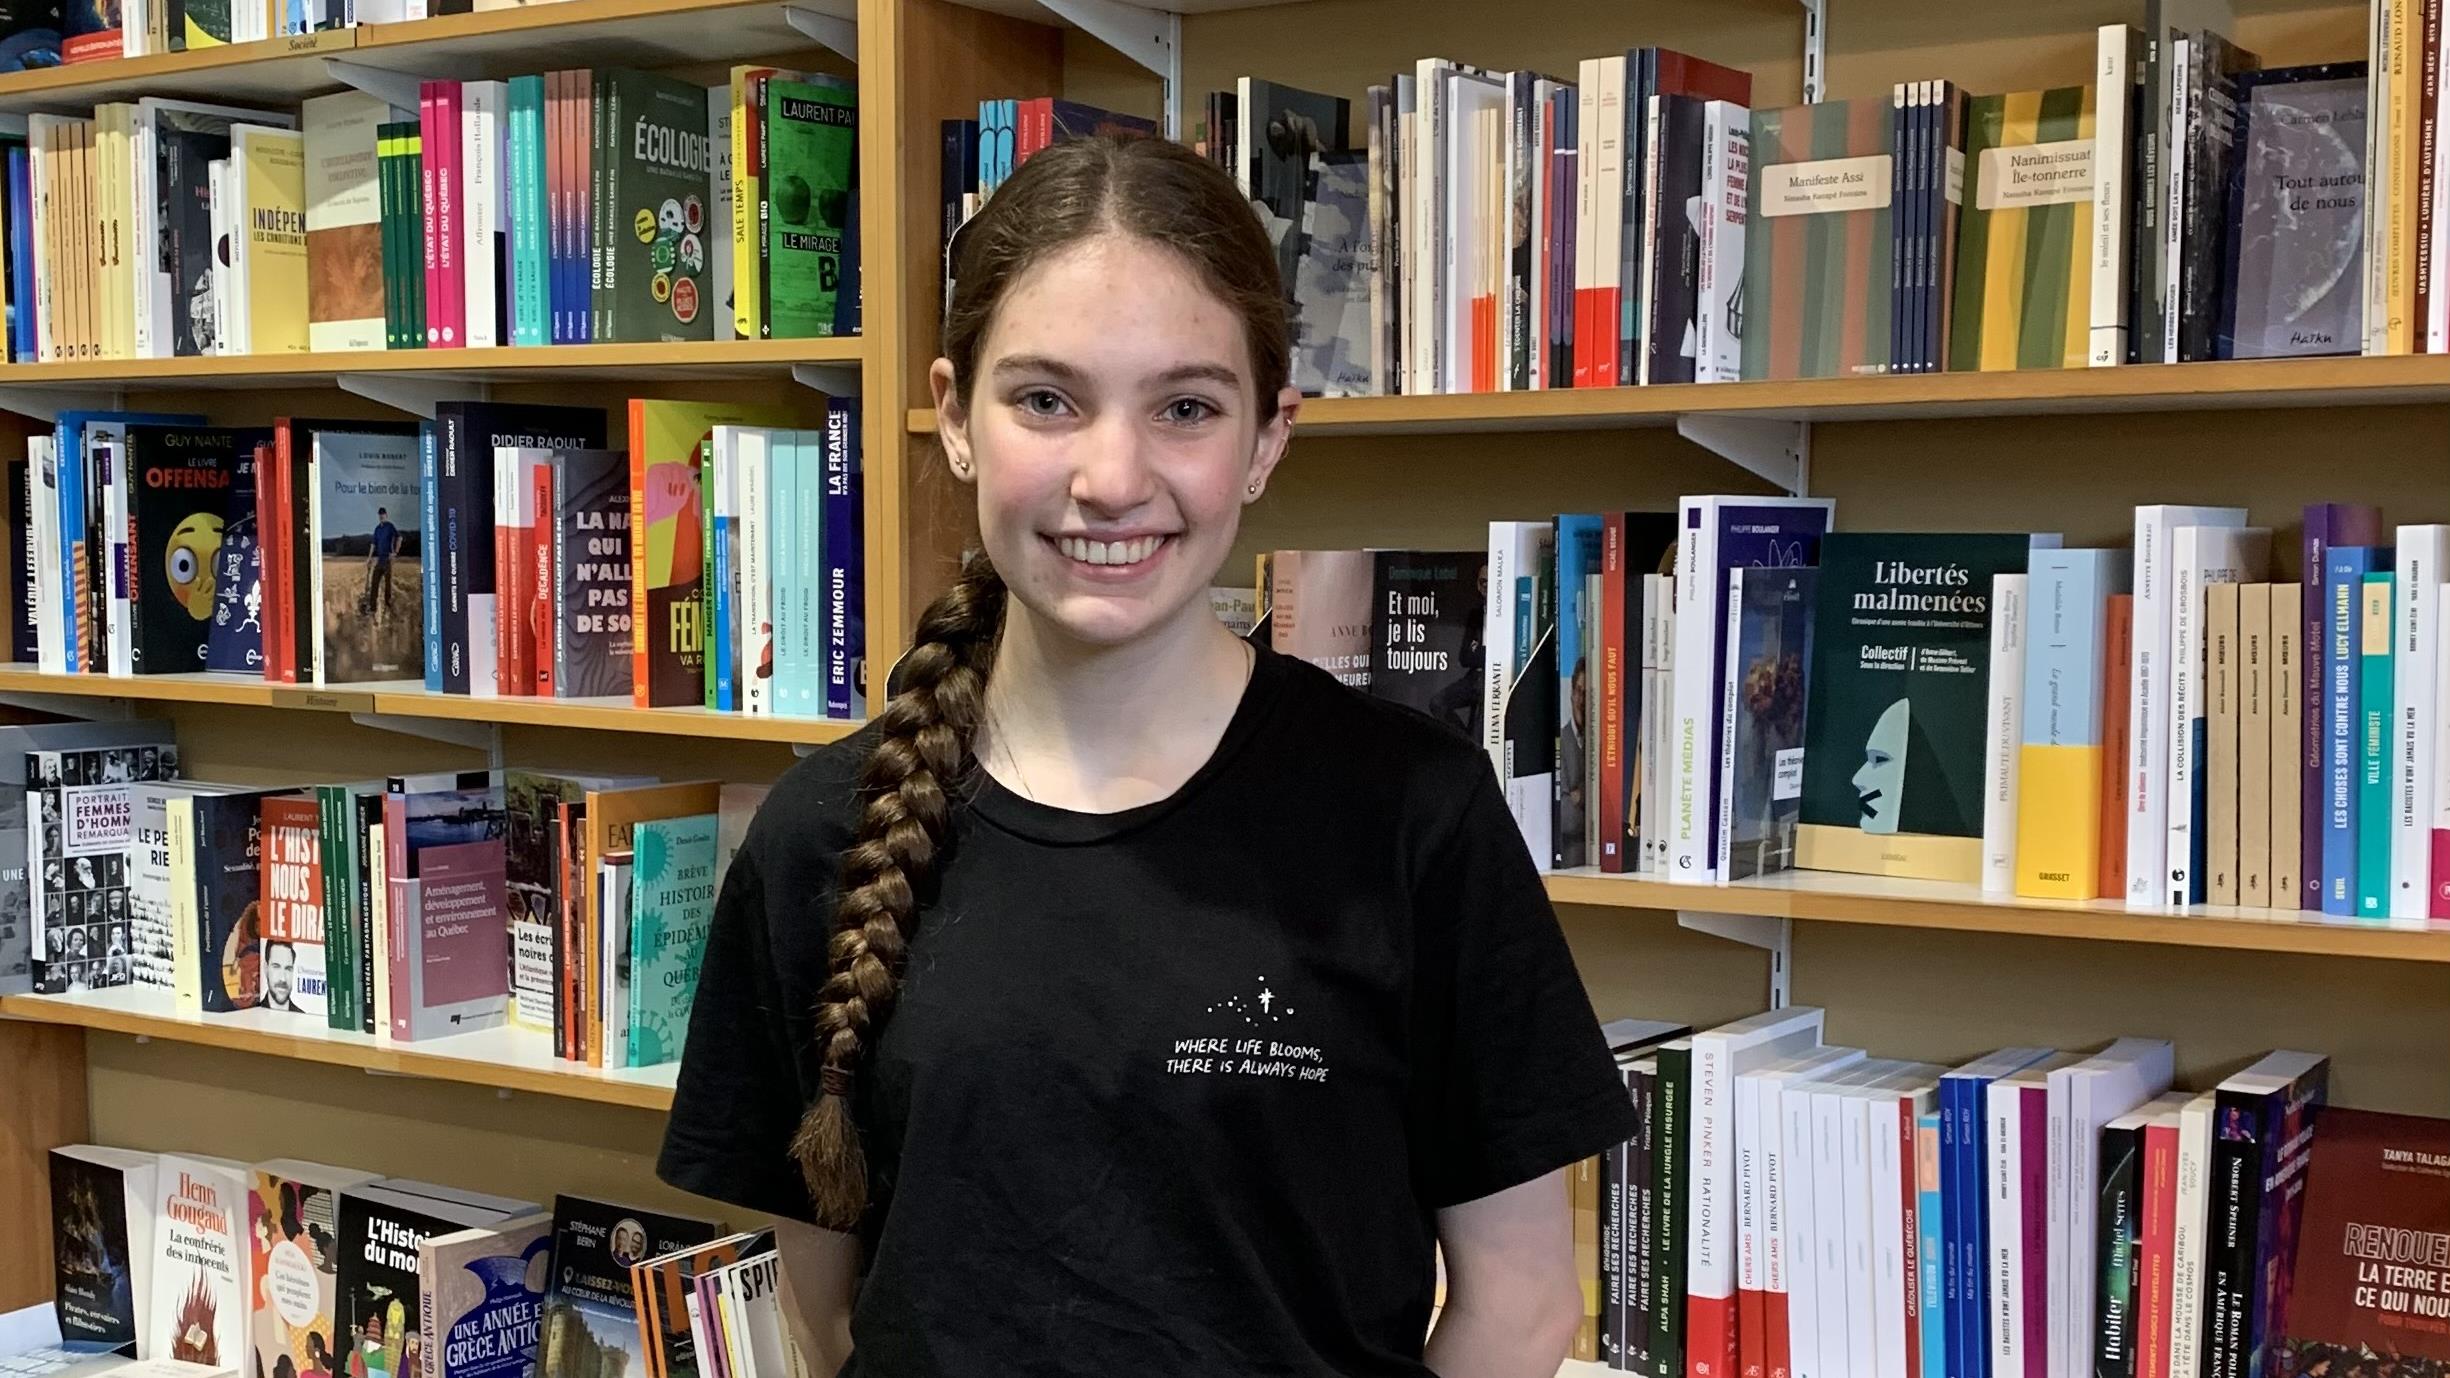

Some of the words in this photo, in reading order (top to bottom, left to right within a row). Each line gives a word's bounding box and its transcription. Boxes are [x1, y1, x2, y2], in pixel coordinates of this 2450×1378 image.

[783, 100, 835, 122] LAURENT
[635, 115, 711, 172] ÉCOLOGIE
[2011, 150, 2091, 167] Nanimissuat
[1789, 173, 1839, 187] Manifeste
[1842, 171, 1864, 183] Assi
[2012, 168, 2087, 184] Île-tonnerre
[2277, 174, 2314, 190] Tout
[423, 170, 434, 215] QUÉBEC
[439, 168, 450, 213] QUÉBEC
[735, 180, 743, 213] TEMPS
[2290, 196, 2310, 211] de
[2316, 196, 2356, 210] nous
[2420, 178, 2431, 220] LUMIÈRE
[425, 217, 433, 233] DU
[440, 215, 449, 232] DU
[736, 217, 744, 243] SALE
[784, 234, 798, 250] LE
[800, 234, 841, 252] MIRAGE
[605, 247, 614, 289] ÉCOLOGIE
[1332, 260, 1353, 272] des
[165, 434, 191, 447] GUY
[491, 434, 534, 448] DIDIER
[537, 436, 587, 450] RAOULT
[828, 410, 841, 472] FRANCE
[188, 458, 197, 467] LE
[146, 467, 230, 488] OFFENSA
[335, 481, 356, 495] Pour
[828, 475, 841, 495] LA
[576, 512, 604, 530] LA
[129, 513, 139, 601] OFFENSANT
[588, 538, 622, 556] QUI
[1689, 532, 1697, 573] BOULANGER
[536, 544, 548, 598] DÉCADENCE
[1875, 561, 1969, 586] Libertés
[588, 589, 628, 607] PAS
[832, 568, 845, 646] ZEMMOUR
[1388, 591, 1402, 615] Et
[1407, 591, 1439, 619] moi,
[1853, 587, 1986, 613] malmenées
[2336, 584, 2349, 631] ELLMANN
[577, 615, 604, 632] DE
[1386, 618, 1401, 646] je
[1407, 618, 1425, 643] lis
[2310, 621, 2320, 652] Motel
[1387, 646, 1448, 674] toujours
[1606, 647, 1617, 669] FAUT
[1861, 645, 1908, 661] Collectif
[2336, 634, 2349, 660] LUCY
[832, 650, 845, 685] ERIC
[2310, 654, 2320, 688] Mauve
[2335, 665, 2348, 693] NOUS
[1490, 661, 1502, 711] FERRANTE
[2177, 672, 2186, 702] RÉCITS
[1726, 713, 1733, 722] du
[2177, 704, 2185, 721] DES
[2335, 695, 2348, 735] CONTRE
[1490, 714, 1501, 745] ELENA
[1724, 724, 1733, 756] théories
[1680, 718, 1694, 774] MÉDIAS
[2177, 723, 2185, 768] COLLISION
[2335, 739, 2348, 765] SONT
[2177, 770, 2184, 781] LA
[2367, 760, 2380, 784] VILLE
[2335, 767, 2348, 808] CHOSES
[77, 803, 130, 817] FEMMES
[1680, 776, 1693, 841] PLANÈTE
[2335, 809, 2348, 828] LES
[138, 828, 151, 845] LE
[2, 868, 24, 881] UNE
[271, 862, 310, 902] NOUS
[677, 865, 708, 882] BRÈVE
[425, 894, 487, 911] développement
[435, 906, 497, 923] environnement
[683, 908, 701, 920] DES
[270, 901, 287, 938] LE
[518, 928, 533, 943] Les
[519, 945, 546, 960] noires
[1174, 1038, 1229, 1054] WHERE
[1235, 1039, 1263, 1055] LIFE
[1269, 1041, 1323, 1063] BLOOMS,
[1166, 1058, 1214, 1074] THERE
[1220, 1060, 1234, 1073] IS
[1238, 1059, 1296, 1078] ALWAYS
[1299, 1066, 1329, 1083] HOPE
[1704, 1052, 1714, 1106] STEVEN
[1664, 1081, 1674, 1134] INSURGÉE
[1663, 1137, 1673, 1175] JUNGLE
[1702, 1117, 1713, 1168] PINKER
[2383, 1149, 2413, 1163] TANYA
[1742, 1148, 1751, 1178] PIVOT
[1768, 1152, 1776, 1182] PIVOT
[180, 1171, 217, 1207] Henri
[1663, 1178, 1672, 1190] LA
[2229, 1157, 2242, 1202] NORBERT
[1663, 1192, 1671, 1206] DE
[1743, 1181, 1752, 1227] BERNARD
[1769, 1185, 1778, 1232] BERNARD
[167, 1194, 228, 1237] Gougaud
[1611, 1183, 1620, 1250] RECHERCHES
[1628, 1184, 1638, 1251] RECHERCHES
[1641, 1189, 1651, 1257] RECHERCHES
[1662, 1208, 1671, 1237] LIVRE
[1701, 1178, 1712, 1267] RATIONALITÉ
[170, 1229, 182, 1244] La
[184, 1238, 226, 1261] confrérie
[364, 1240, 386, 1265] du
[1662, 1239, 1671, 1251] LE
[166, 1250, 183, 1266] des
[185, 1254, 230, 1278] innocents
[1611, 1253, 1620, 1273] SES
[1628, 1254, 1638, 1274] SES
[1640, 1259, 1650, 1279] SES
[1906, 1259, 1914, 1269] LE
[2358, 1262, 2380, 1283] LA
[2384, 1265, 2437, 1291] TERRE
[1611, 1274, 1620, 1304] FAIRE
[1628, 1275, 1638, 1306] FAIRE
[1660, 1276, 1670, 1304] SHAH
[2176, 1271, 2184, 1284] DE
[2218, 1271, 2227, 1285] EN
[1640, 1281, 1650, 1312] FAIRE
[2175, 1287, 2183, 1325] MOUSSE
[2184, 1303, 2192, 1313] LE
[2231, 1293, 2243, 1306] LE
[2355, 1286, 2377, 1308] CE
[2380, 1290, 2409, 1313] QUI
[422, 1290, 434, 1341] ANTIQUE
[454, 1320, 480, 1340] UNE
[482, 1302, 532, 1333] ANNÉE
[1660, 1306, 1669, 1332] ALPA
[2105, 1296, 2122, 1360] Habiter
[2183, 1316, 2191, 1341] DANS
[2215, 1288, 2227, 1343] AMÉRIQUE
[2174, 1327, 2182, 1339] LA
[2229, 1311, 2243, 1349] ROMAN
[446, 1334, 496, 1368] GRÈCE
